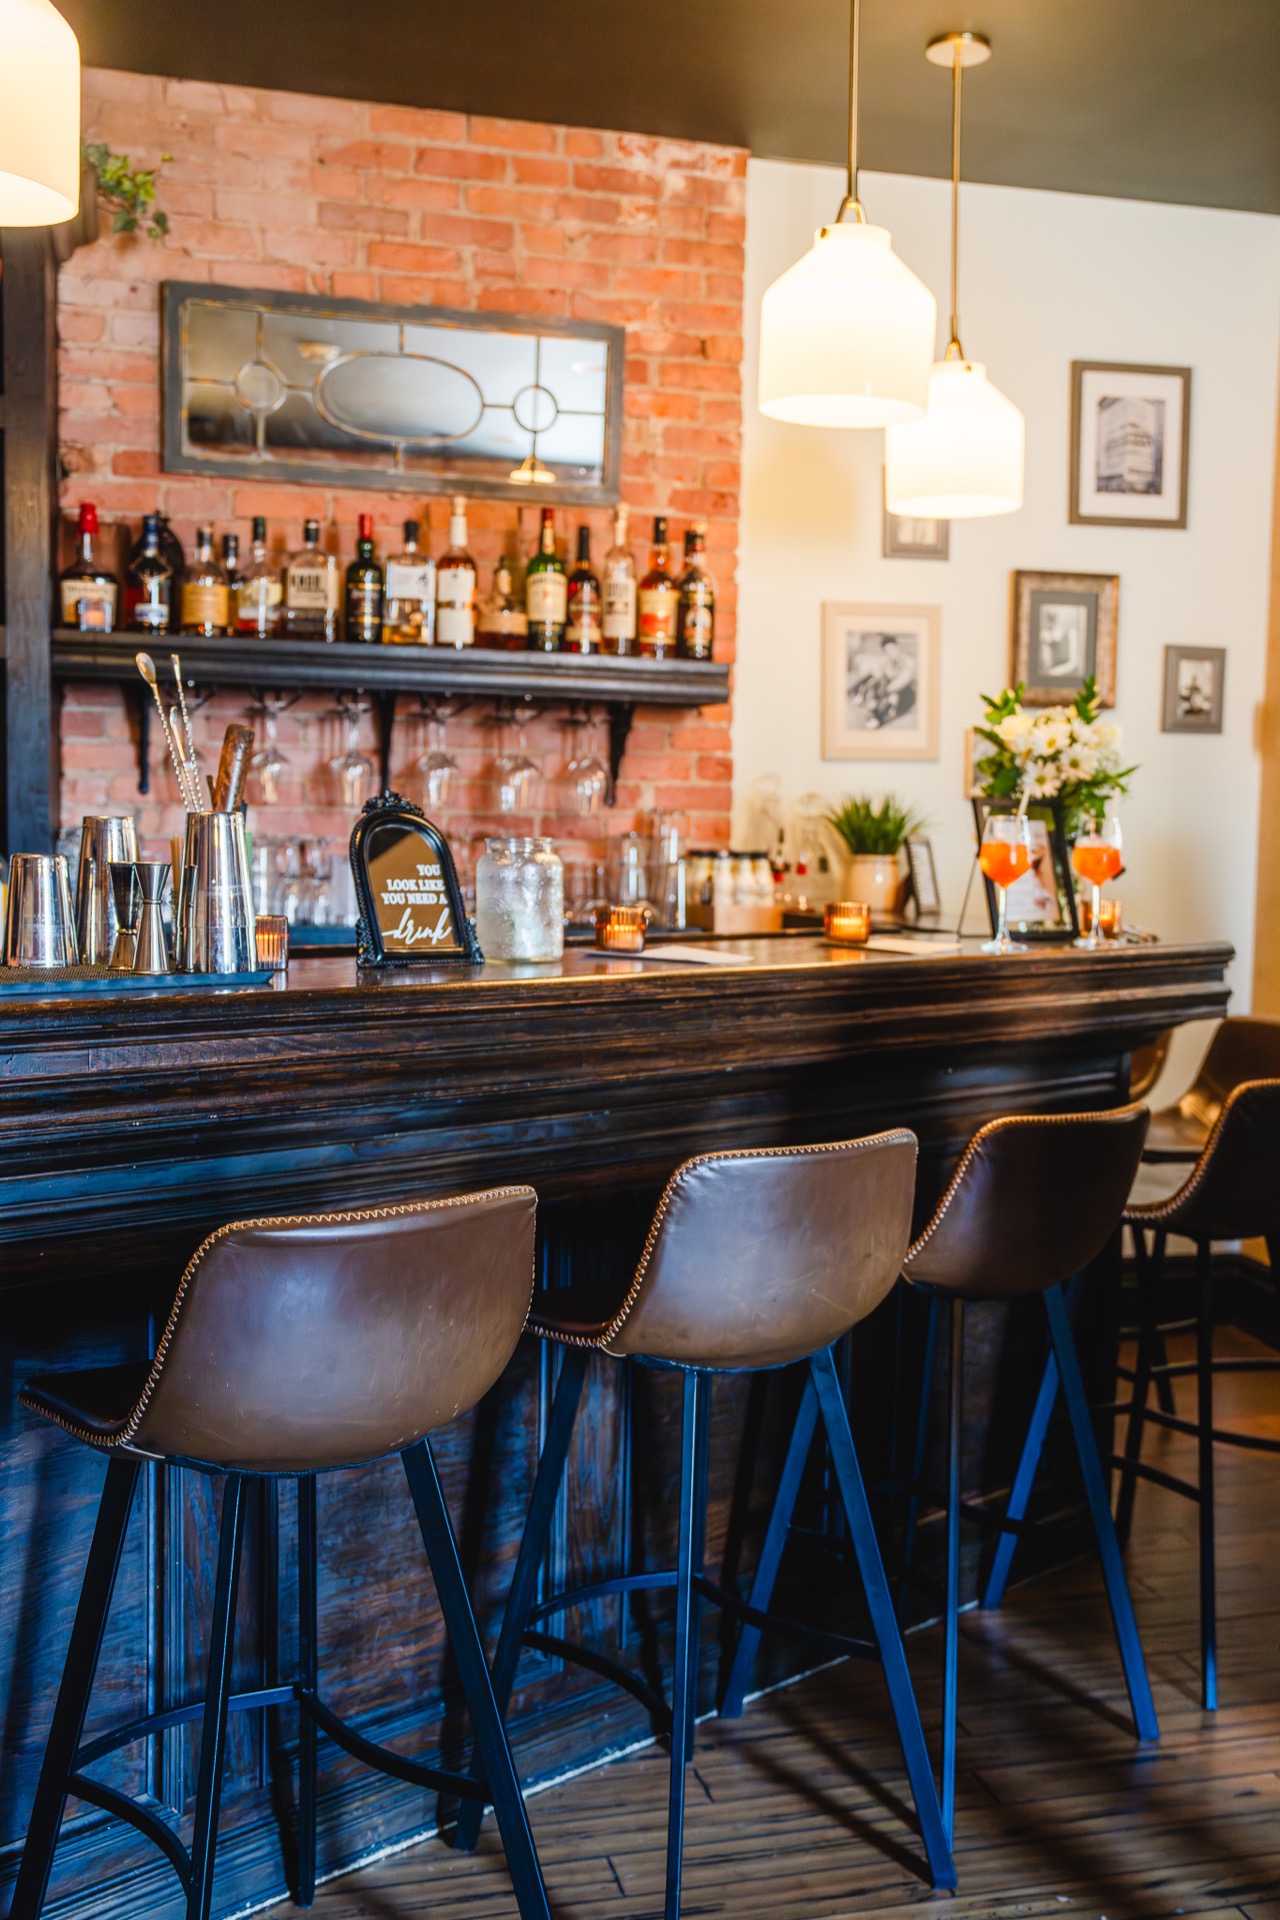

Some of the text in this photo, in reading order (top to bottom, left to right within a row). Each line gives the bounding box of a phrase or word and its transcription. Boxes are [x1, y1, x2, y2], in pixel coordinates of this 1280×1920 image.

[416, 864, 441, 877] YOU
[387, 879, 445, 891] LOOK LIKE
[381, 893, 448, 905] YOU NEED A
[381, 907, 452, 945] drink
